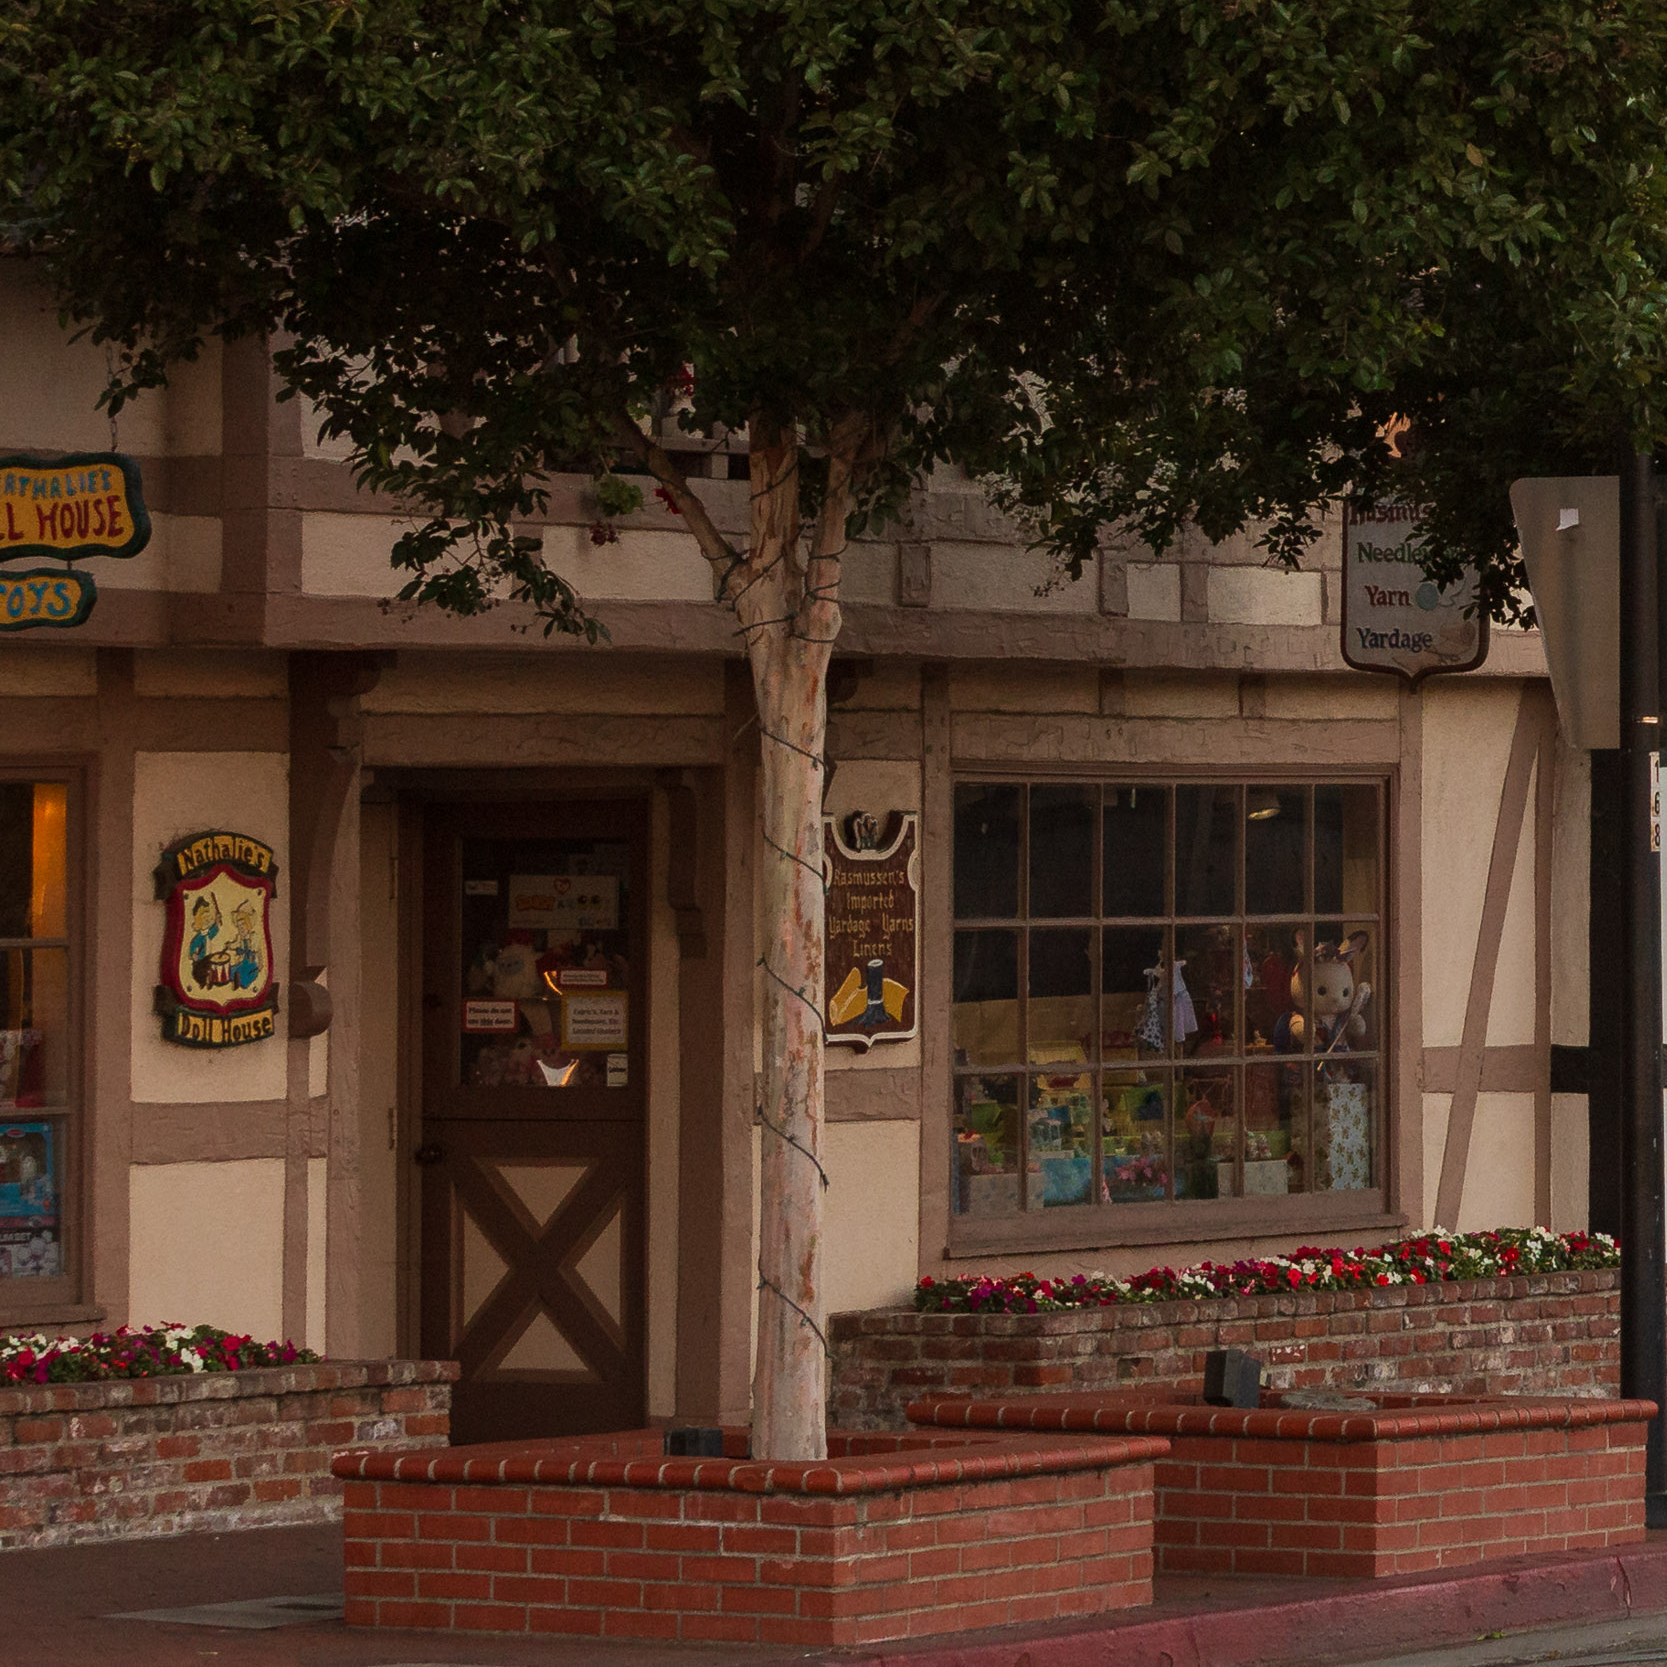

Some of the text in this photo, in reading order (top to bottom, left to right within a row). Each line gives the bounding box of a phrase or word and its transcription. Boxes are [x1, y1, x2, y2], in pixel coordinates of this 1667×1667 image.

[4, 468, 111, 500] ATHALIE'S
[36, 495, 124, 541] HOUSE
[0, 582, 71, 618] OYS
[1364, 585, 1412, 607] Yarn
[1356, 628, 1433, 654] Yardage
[183, 837, 266, 872] Nathalie's
[833, 868, 905, 886] Rasmussen's
[846, 888, 895, 915] Imported
[828, 912, 914, 941] Yardage Yarns
[853, 939, 892, 958] Linens
[181, 1014, 272, 1043] Doll House
